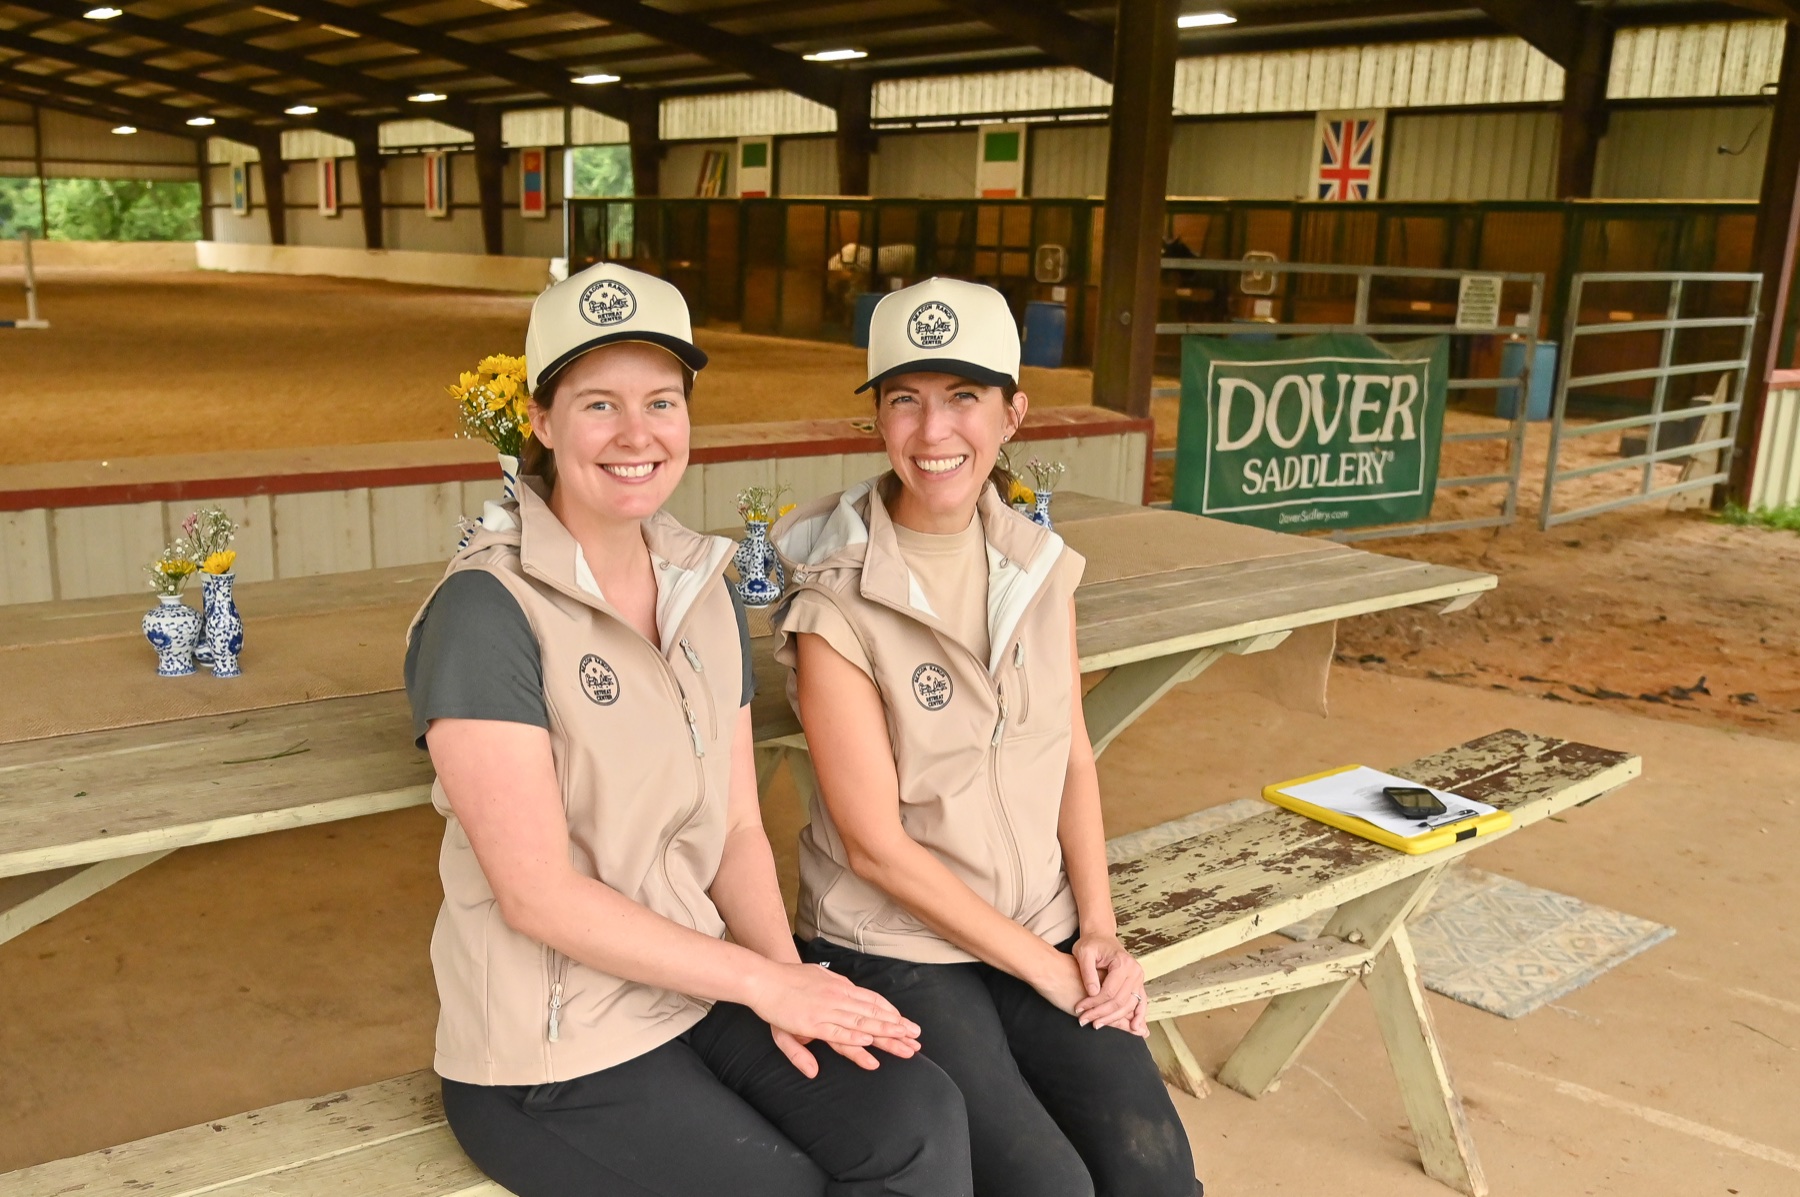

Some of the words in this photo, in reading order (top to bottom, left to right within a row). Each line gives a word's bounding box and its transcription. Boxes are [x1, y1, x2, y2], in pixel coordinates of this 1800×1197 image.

[584, 284, 604, 302] BEACON
[608, 283, 628, 296] RANCH
[597, 311, 622, 319] RETREAT
[912, 304, 933, 322] BEACON
[935, 304, 953, 320] RANCH
[1215, 374, 1419, 451] DOVER
[926, 694, 944, 702] RETREAT
[928, 699, 944, 707] CENTER
